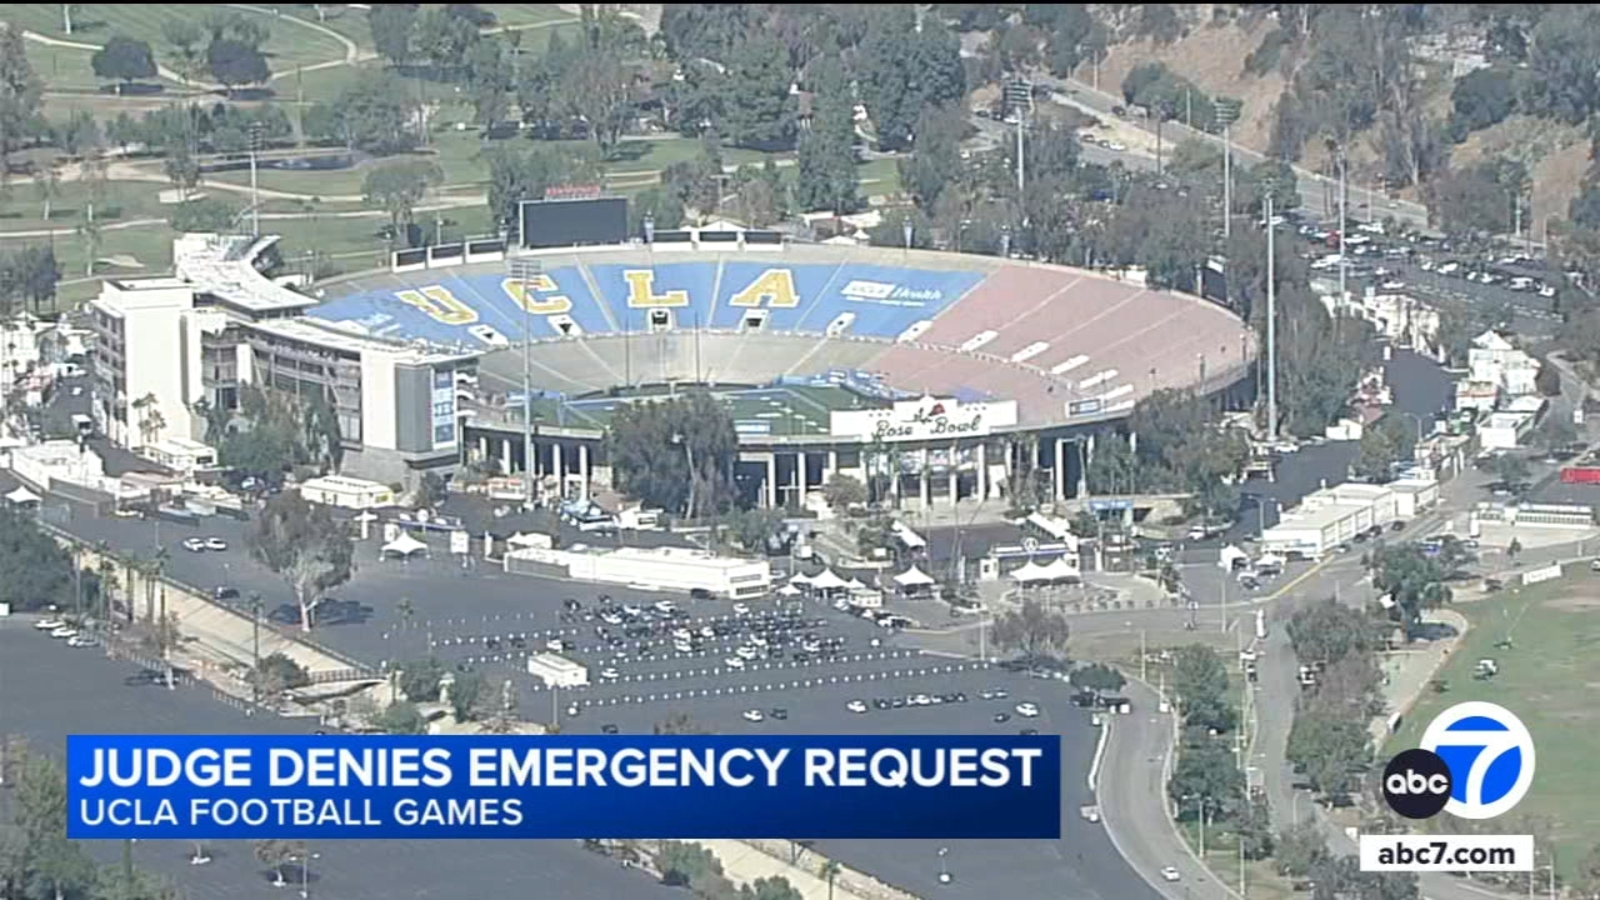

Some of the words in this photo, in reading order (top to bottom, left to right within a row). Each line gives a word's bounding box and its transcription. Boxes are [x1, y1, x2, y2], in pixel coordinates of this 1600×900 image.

[394, 268, 800, 326] UCLA
[874, 420, 913, 437] Rose
[930, 414, 982, 434] Bowl
